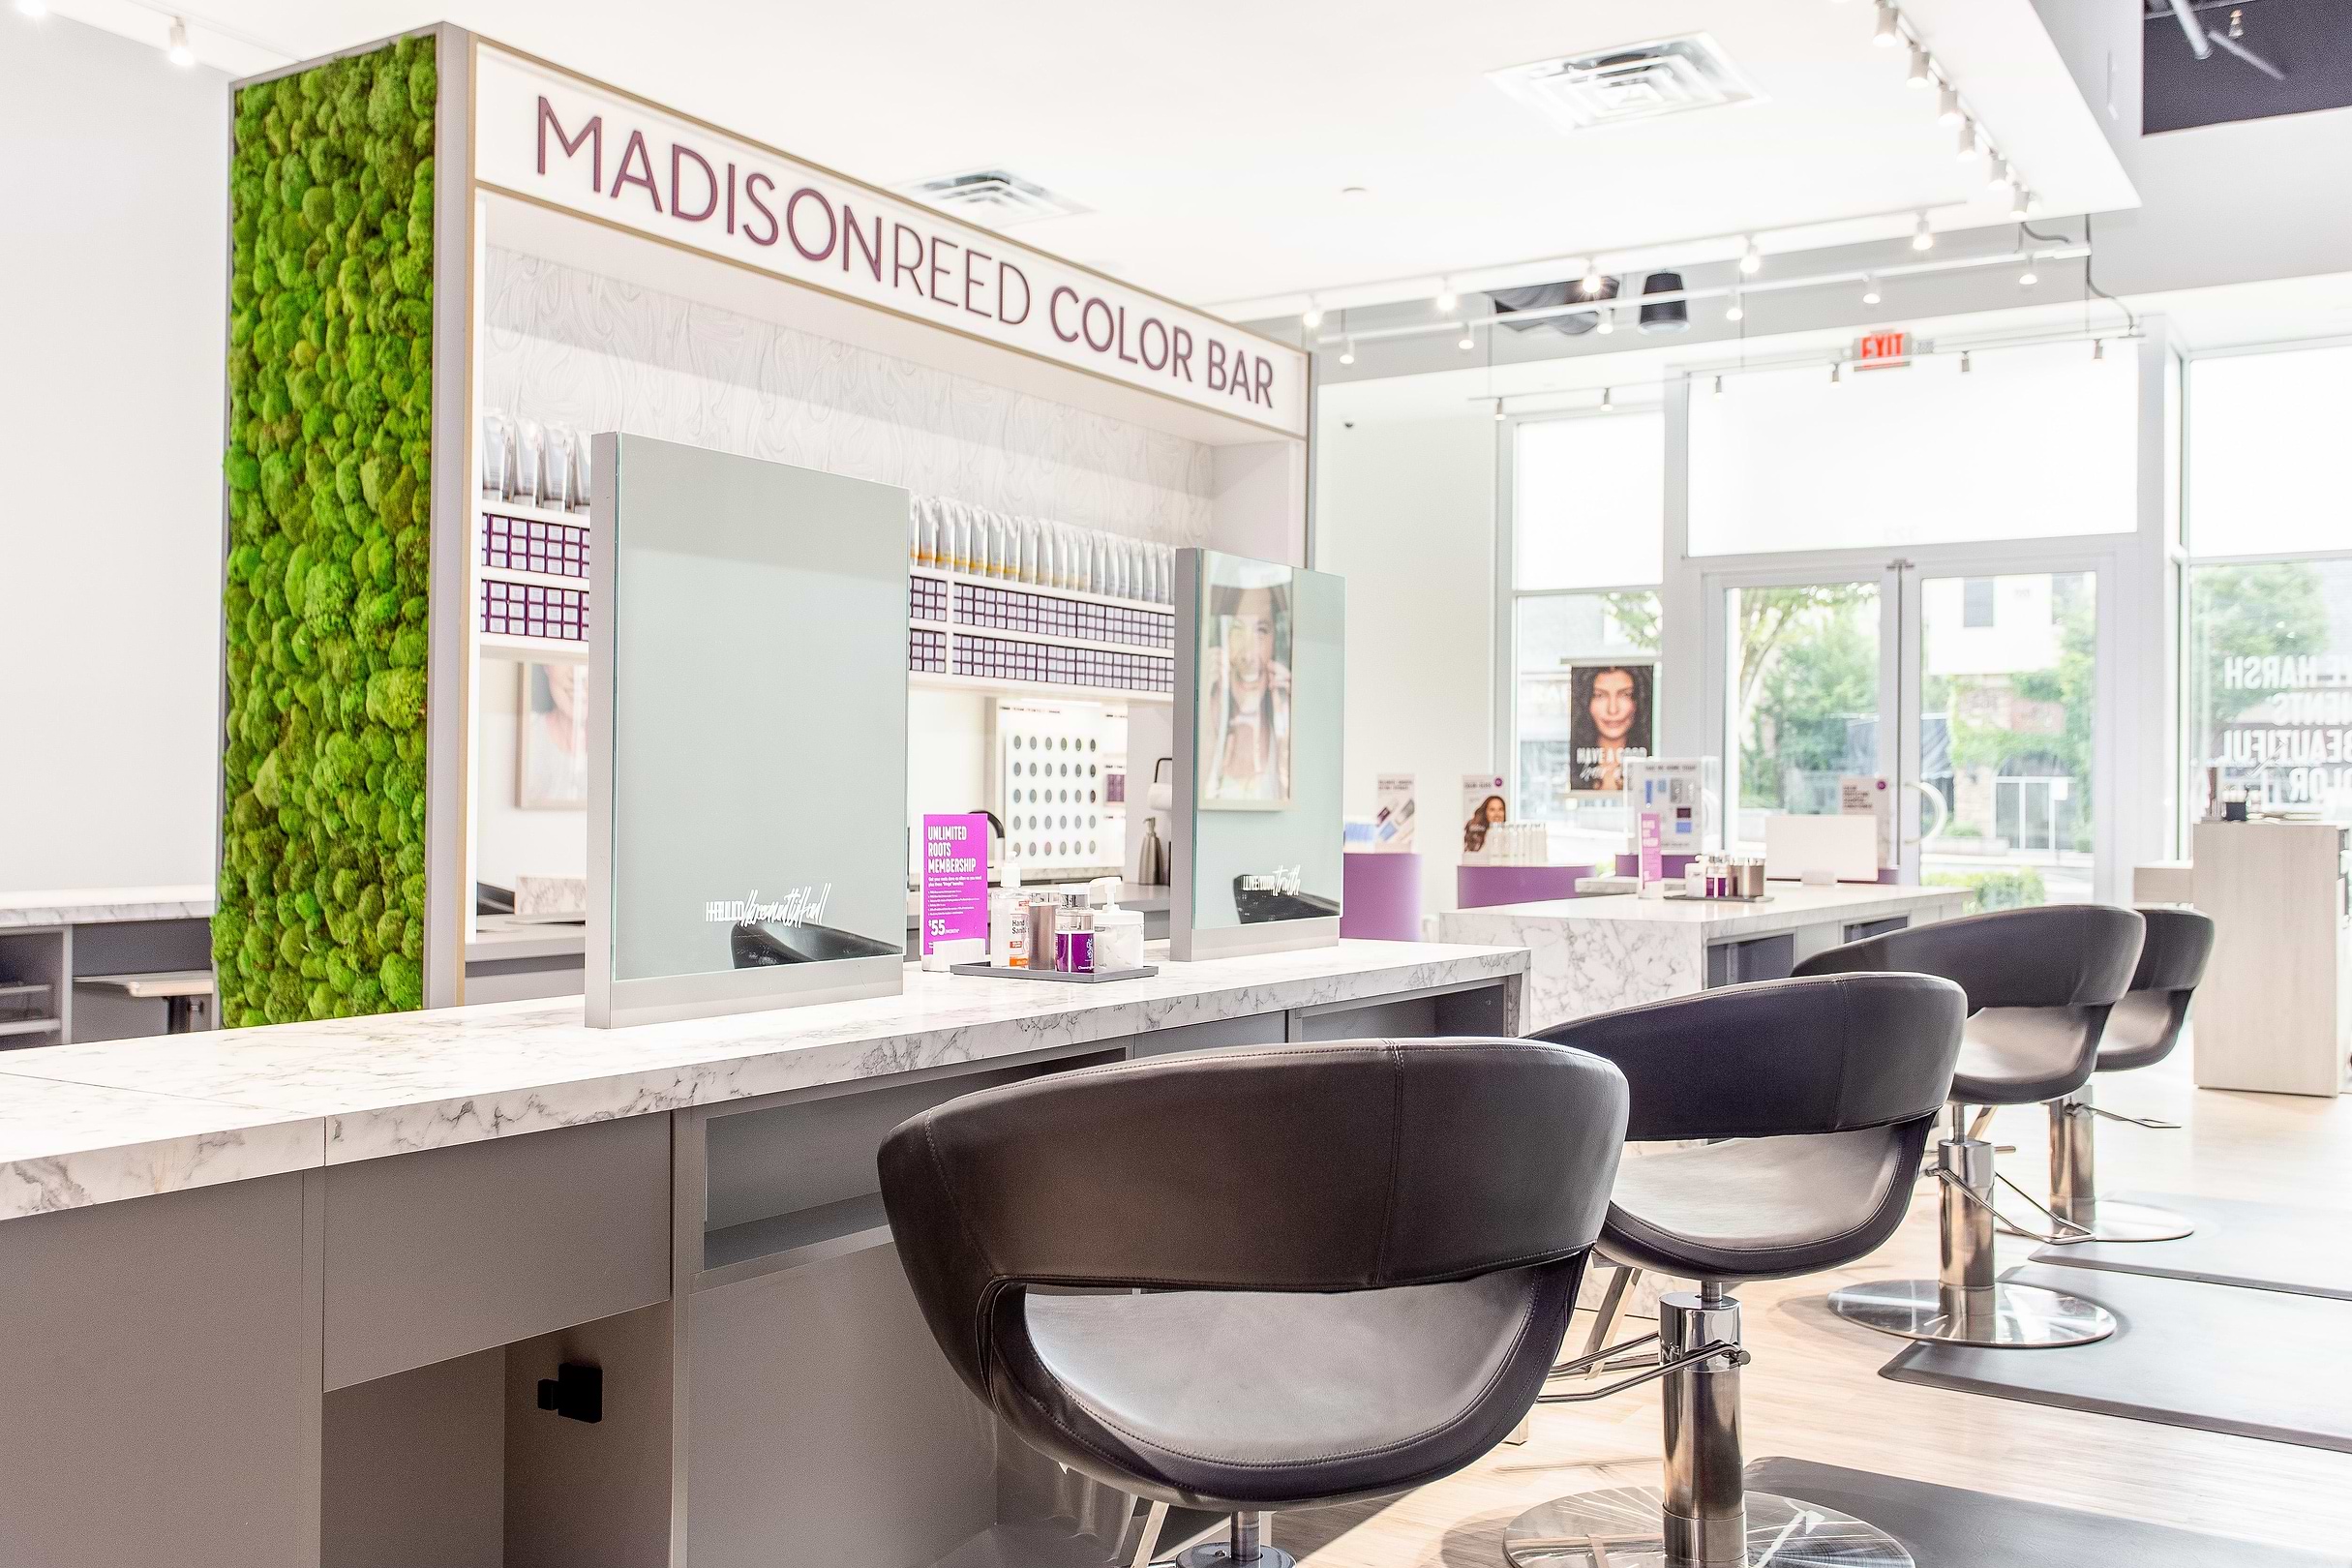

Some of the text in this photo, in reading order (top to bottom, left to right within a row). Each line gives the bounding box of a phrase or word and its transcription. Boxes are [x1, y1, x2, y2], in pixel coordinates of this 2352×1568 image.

[1049, 286, 1194, 382] COLOR
[1208, 339, 1275, 409] BAR
[1860, 333, 1905, 359] EXIT
[927, 826, 967, 841] UNLIMITED
[927, 842, 951, 857] ROOTS
[927, 858, 977, 873] MEMBERSHIP
